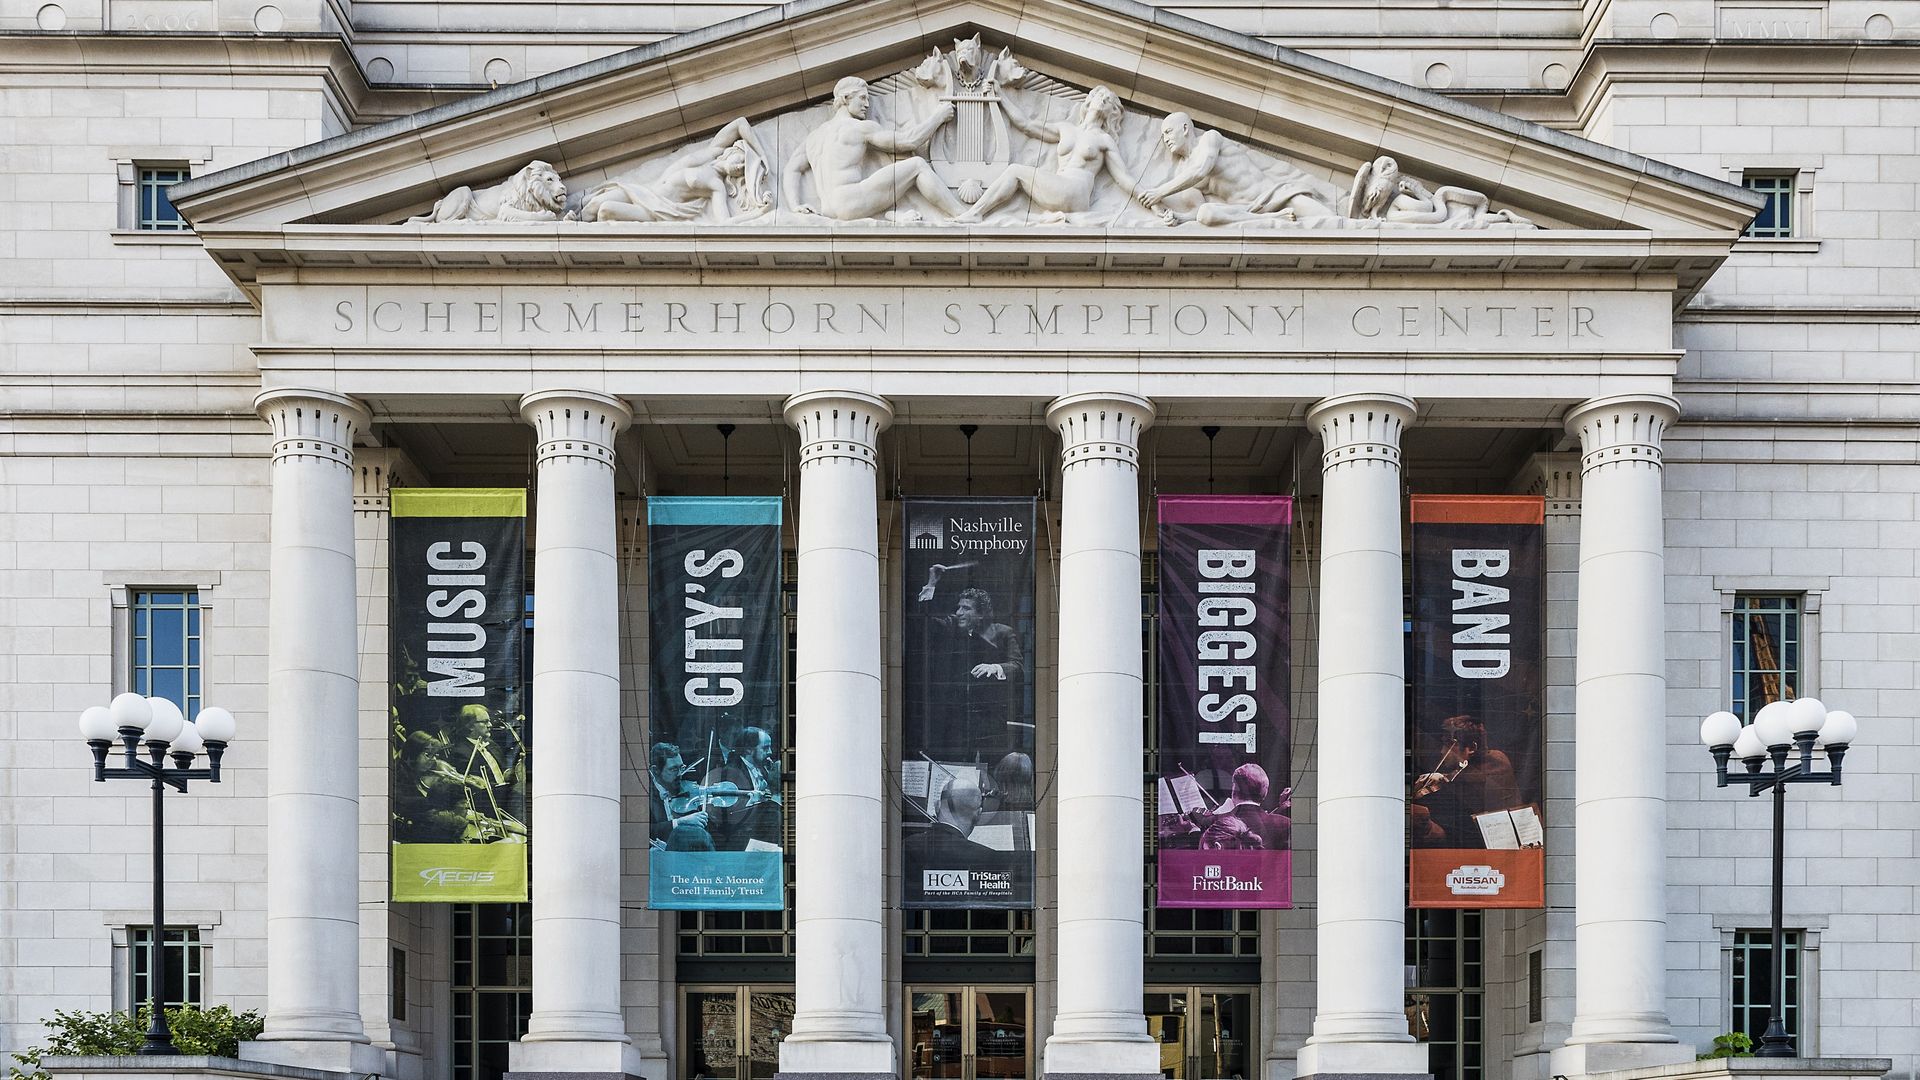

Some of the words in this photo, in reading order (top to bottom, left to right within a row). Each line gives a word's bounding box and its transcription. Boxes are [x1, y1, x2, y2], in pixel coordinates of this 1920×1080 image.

[126, 10, 201, 31] 2006
[334, 300, 891, 334] SCHERMERHORN
[942, 302, 1304, 337] SYMPHONY
[1351, 304, 1604, 338] CENTER
[950, 517, 1023, 533] Nashville
[950, 535, 1028, 555] Symphony
[426, 541, 487, 697] MUSIC
[1452, 549, 1511, 679] BAND
[684, 549, 744, 707] CITY'S
[1197, 549, 1258, 754] BIGGEST
[419, 867, 496, 888] AEGIS
[670, 875, 690, 884] The
[692, 875, 713, 884] Ann
[715, 875, 723, 884] &
[726, 875, 765, 884] Monroe
[927, 873, 965, 887] HCA
[970, 872, 1001, 880] TriStar
[1206, 867, 1220, 877] FB
[979, 881, 1010, 889] Health
[1192, 875, 1263, 891] FirstBank
[1453, 877, 1498, 885] NISSAN
[671, 886, 700, 895] Carell
[703, 886, 737, 898] Family
[737, 886, 764, 895] Trust
